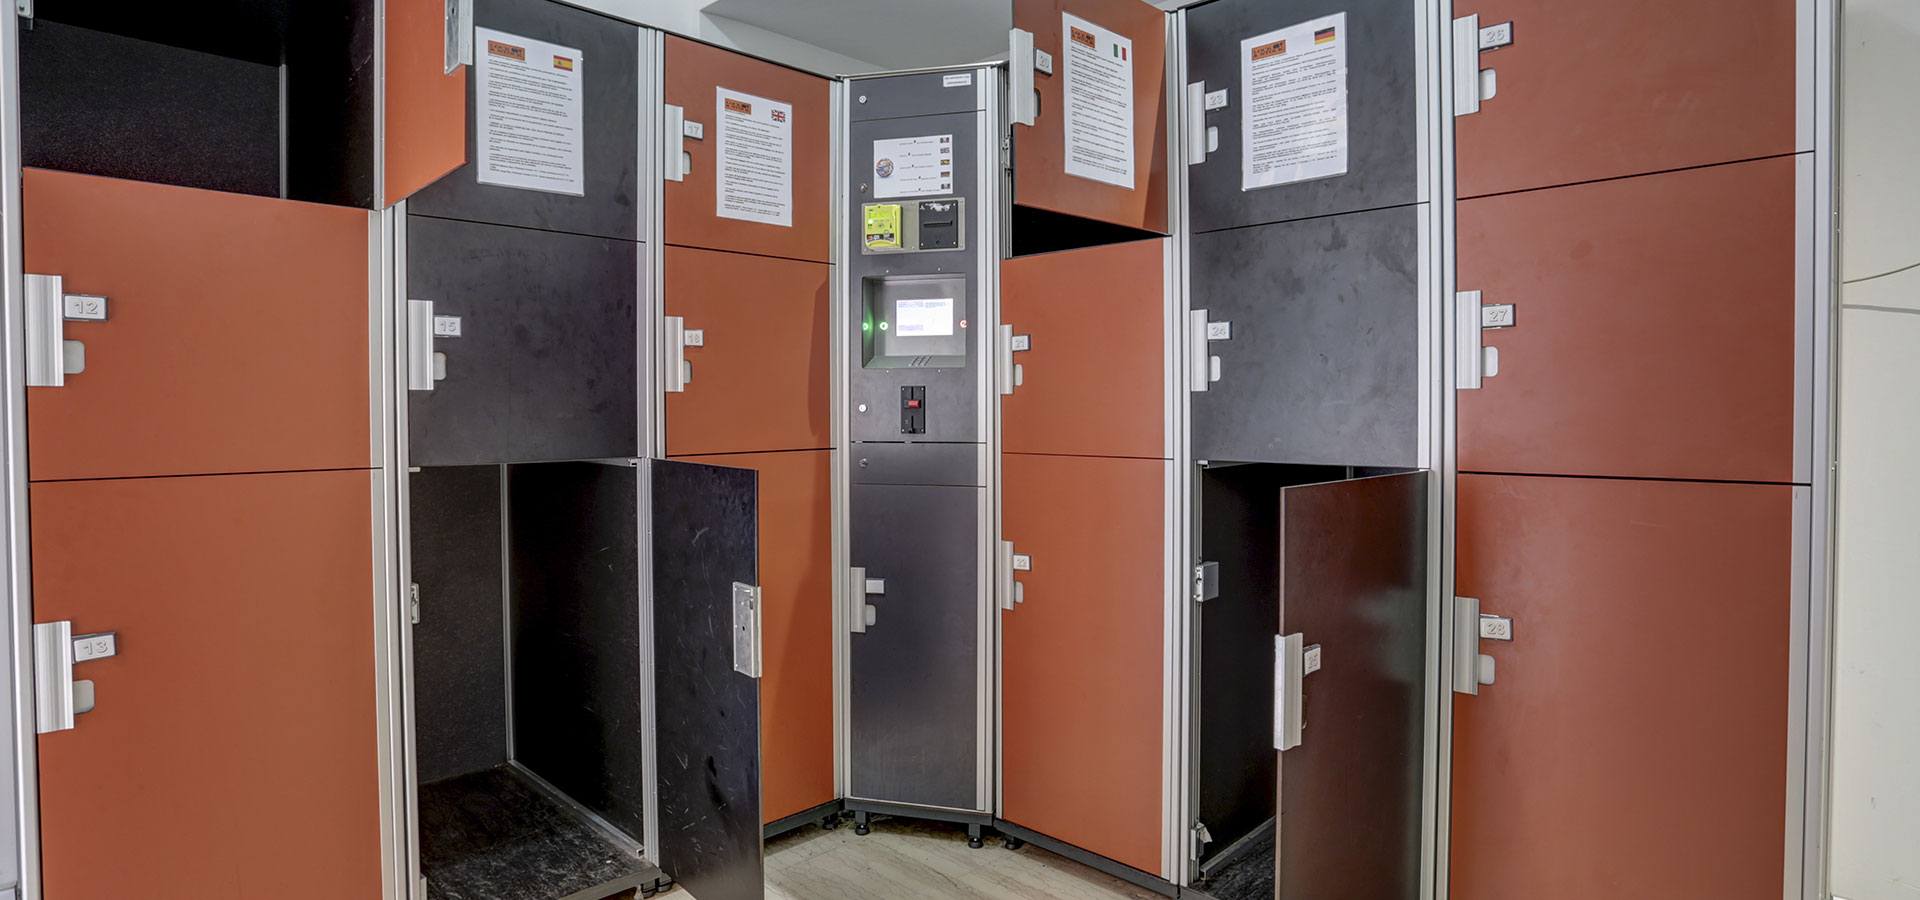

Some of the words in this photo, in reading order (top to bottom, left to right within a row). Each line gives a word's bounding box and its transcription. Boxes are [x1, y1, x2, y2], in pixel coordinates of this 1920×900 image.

[1486, 29, 1505, 44] 26
[1210, 94, 1224, 106] 23
[688, 125, 700, 135] 17
[75, 300, 98, 315] 12
[1488, 309, 1508, 323] 27
[440, 321, 456, 332] 15
[1016, 558, 1027, 568] 22
[1487, 622, 1506, 636] 28
[83, 640, 108, 656] 13
